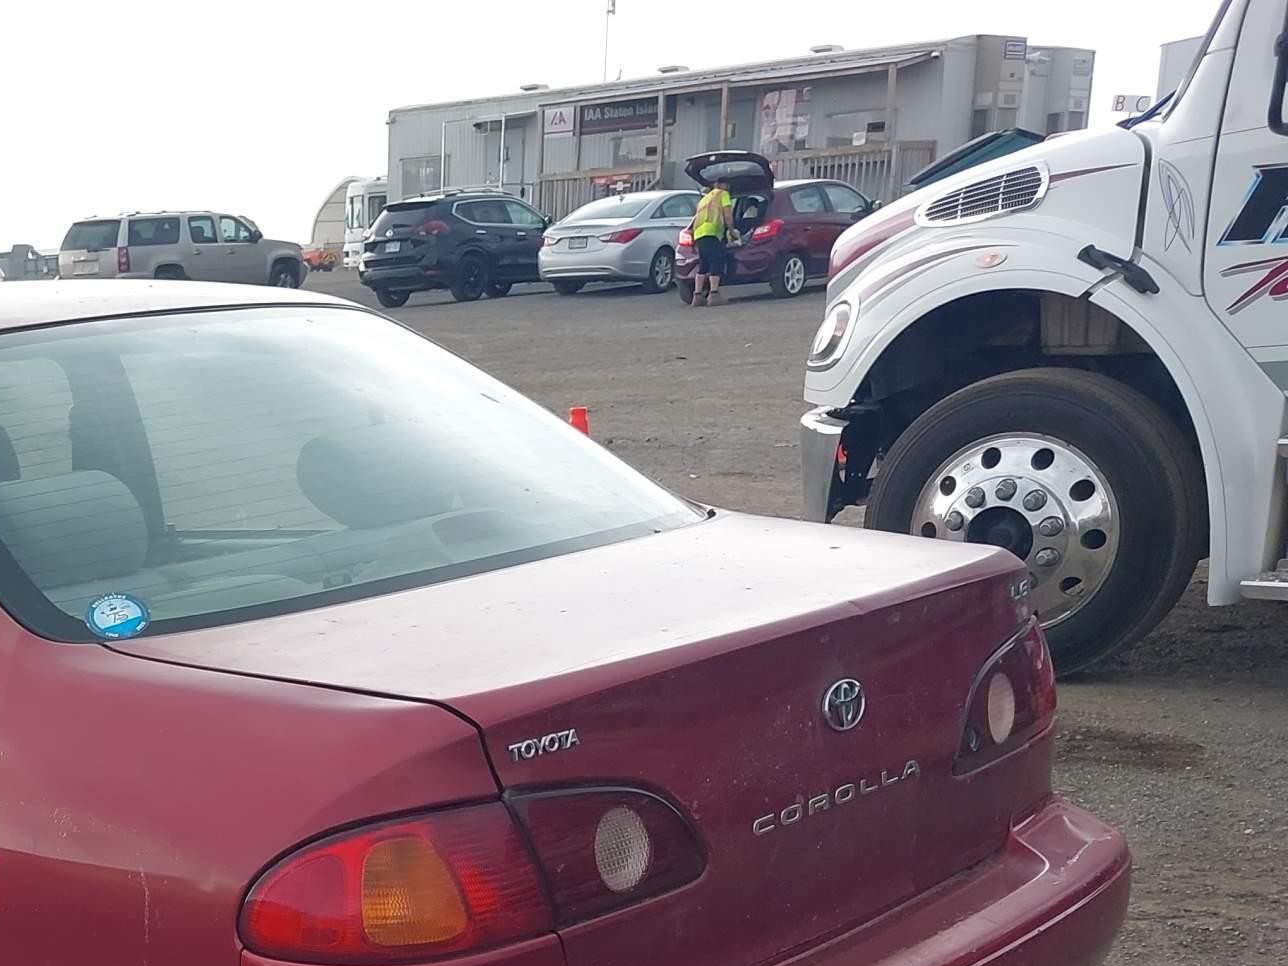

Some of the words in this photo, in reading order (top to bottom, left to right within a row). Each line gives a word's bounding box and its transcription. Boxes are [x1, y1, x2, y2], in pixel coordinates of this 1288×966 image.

[585, 108, 601, 121] IAA
[604, 105, 634, 118] Staten
[636, 101, 659, 115] Islan
[1115, 95, 1126, 111] B
[1011, 580, 1027, 600] LE
[508, 729, 580, 761] TOYOTA
[753, 760, 920, 835] COROLLA
